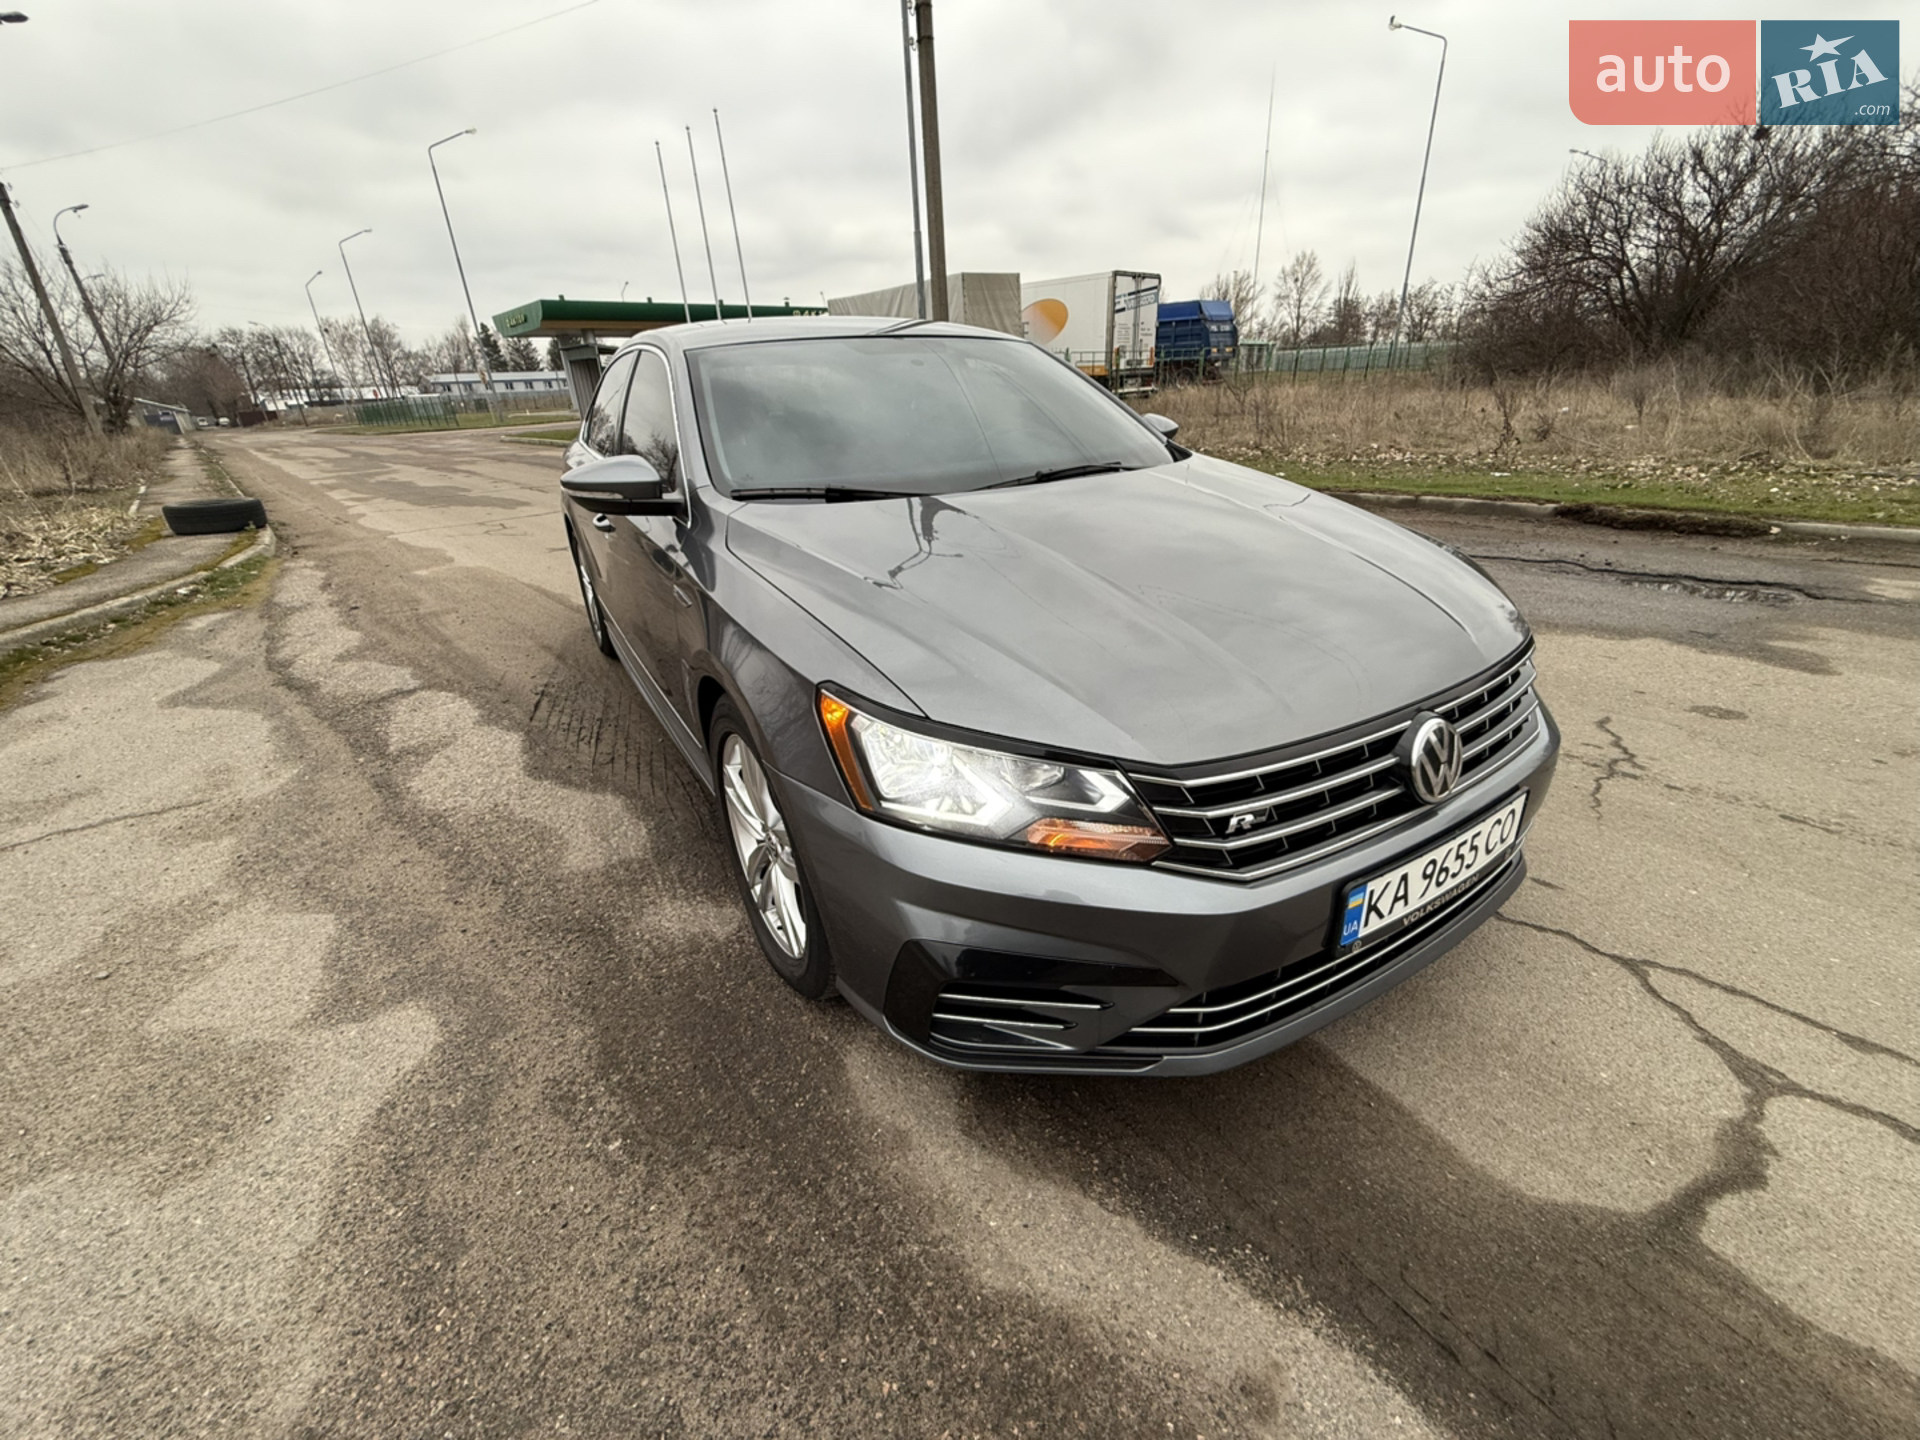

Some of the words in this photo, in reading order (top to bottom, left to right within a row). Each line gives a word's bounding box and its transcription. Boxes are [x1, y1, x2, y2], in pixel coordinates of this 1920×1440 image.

[1363, 872, 1409, 928] KA
[1418, 831, 1482, 900] 9655
[1485, 808, 1516, 856] CO
[1401, 873, 1480, 927] VOLKSWAGEN
[1343, 920, 1358, 936] UA
